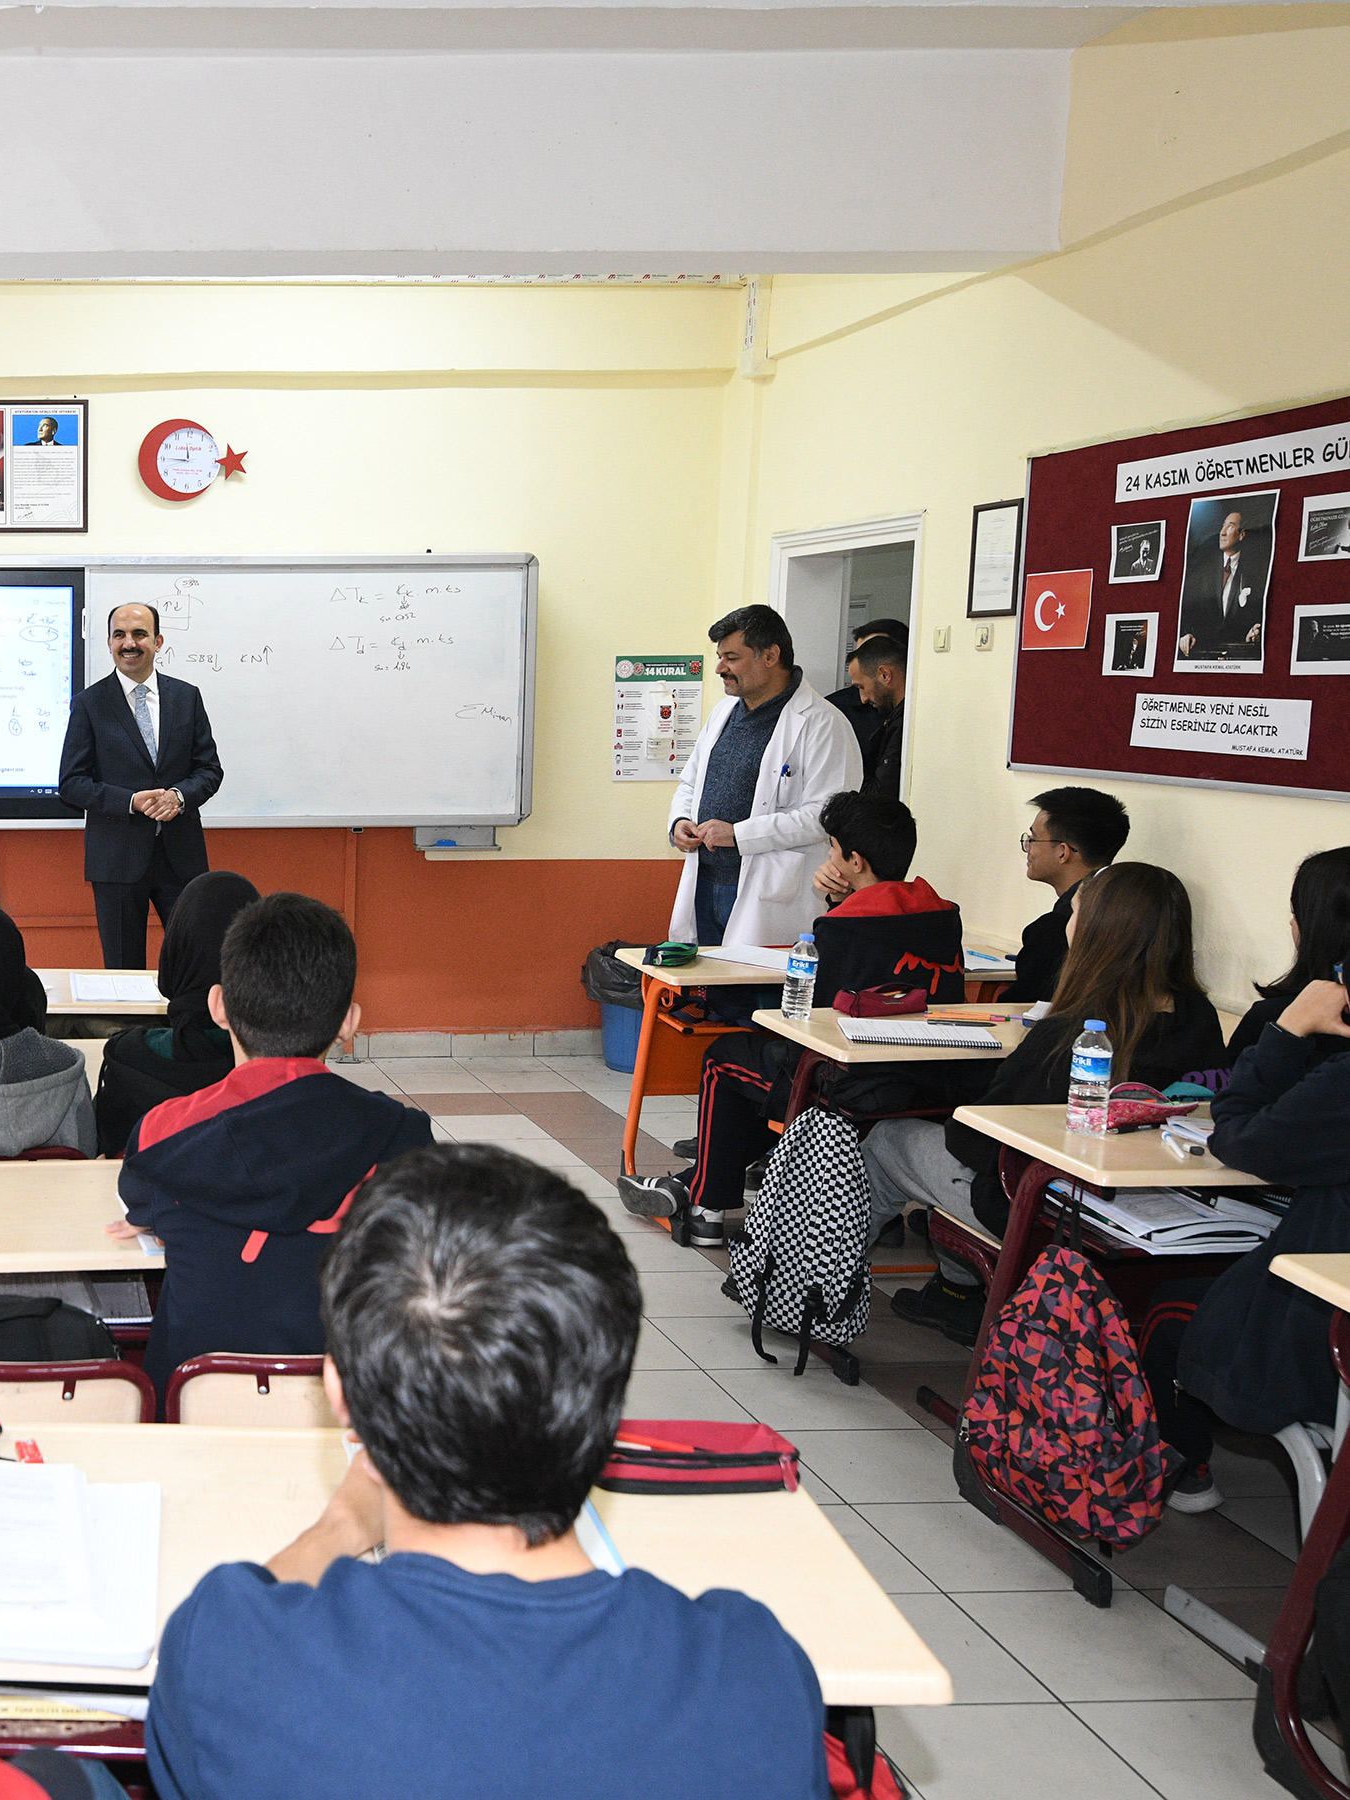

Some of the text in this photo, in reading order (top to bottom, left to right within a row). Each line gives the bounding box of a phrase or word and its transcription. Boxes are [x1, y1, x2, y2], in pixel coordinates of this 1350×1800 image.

[174, 433, 180, 441] 11
[186, 430, 194, 438] 12
[208, 444, 214, 452] 2
[1125, 476, 1140, 492] 24
[1145, 468, 1190, 490] KASIM
[1195, 446, 1315, 483] ÖĞRETMENLER
[656, 667, 686, 676] KURAL
[1141, 698, 1270, 718] ÖĞRETMENLER YENİ NESİL
[1139, 718, 1278, 738] SİZİN ESERİNİZ OLACAKTIR
[1230, 744, 1304, 757] MUSTAFA KEMAL ATATÜRK
[792, 958, 810, 968] Erikli
[1072, 1054, 1092, 1066] Erikli
